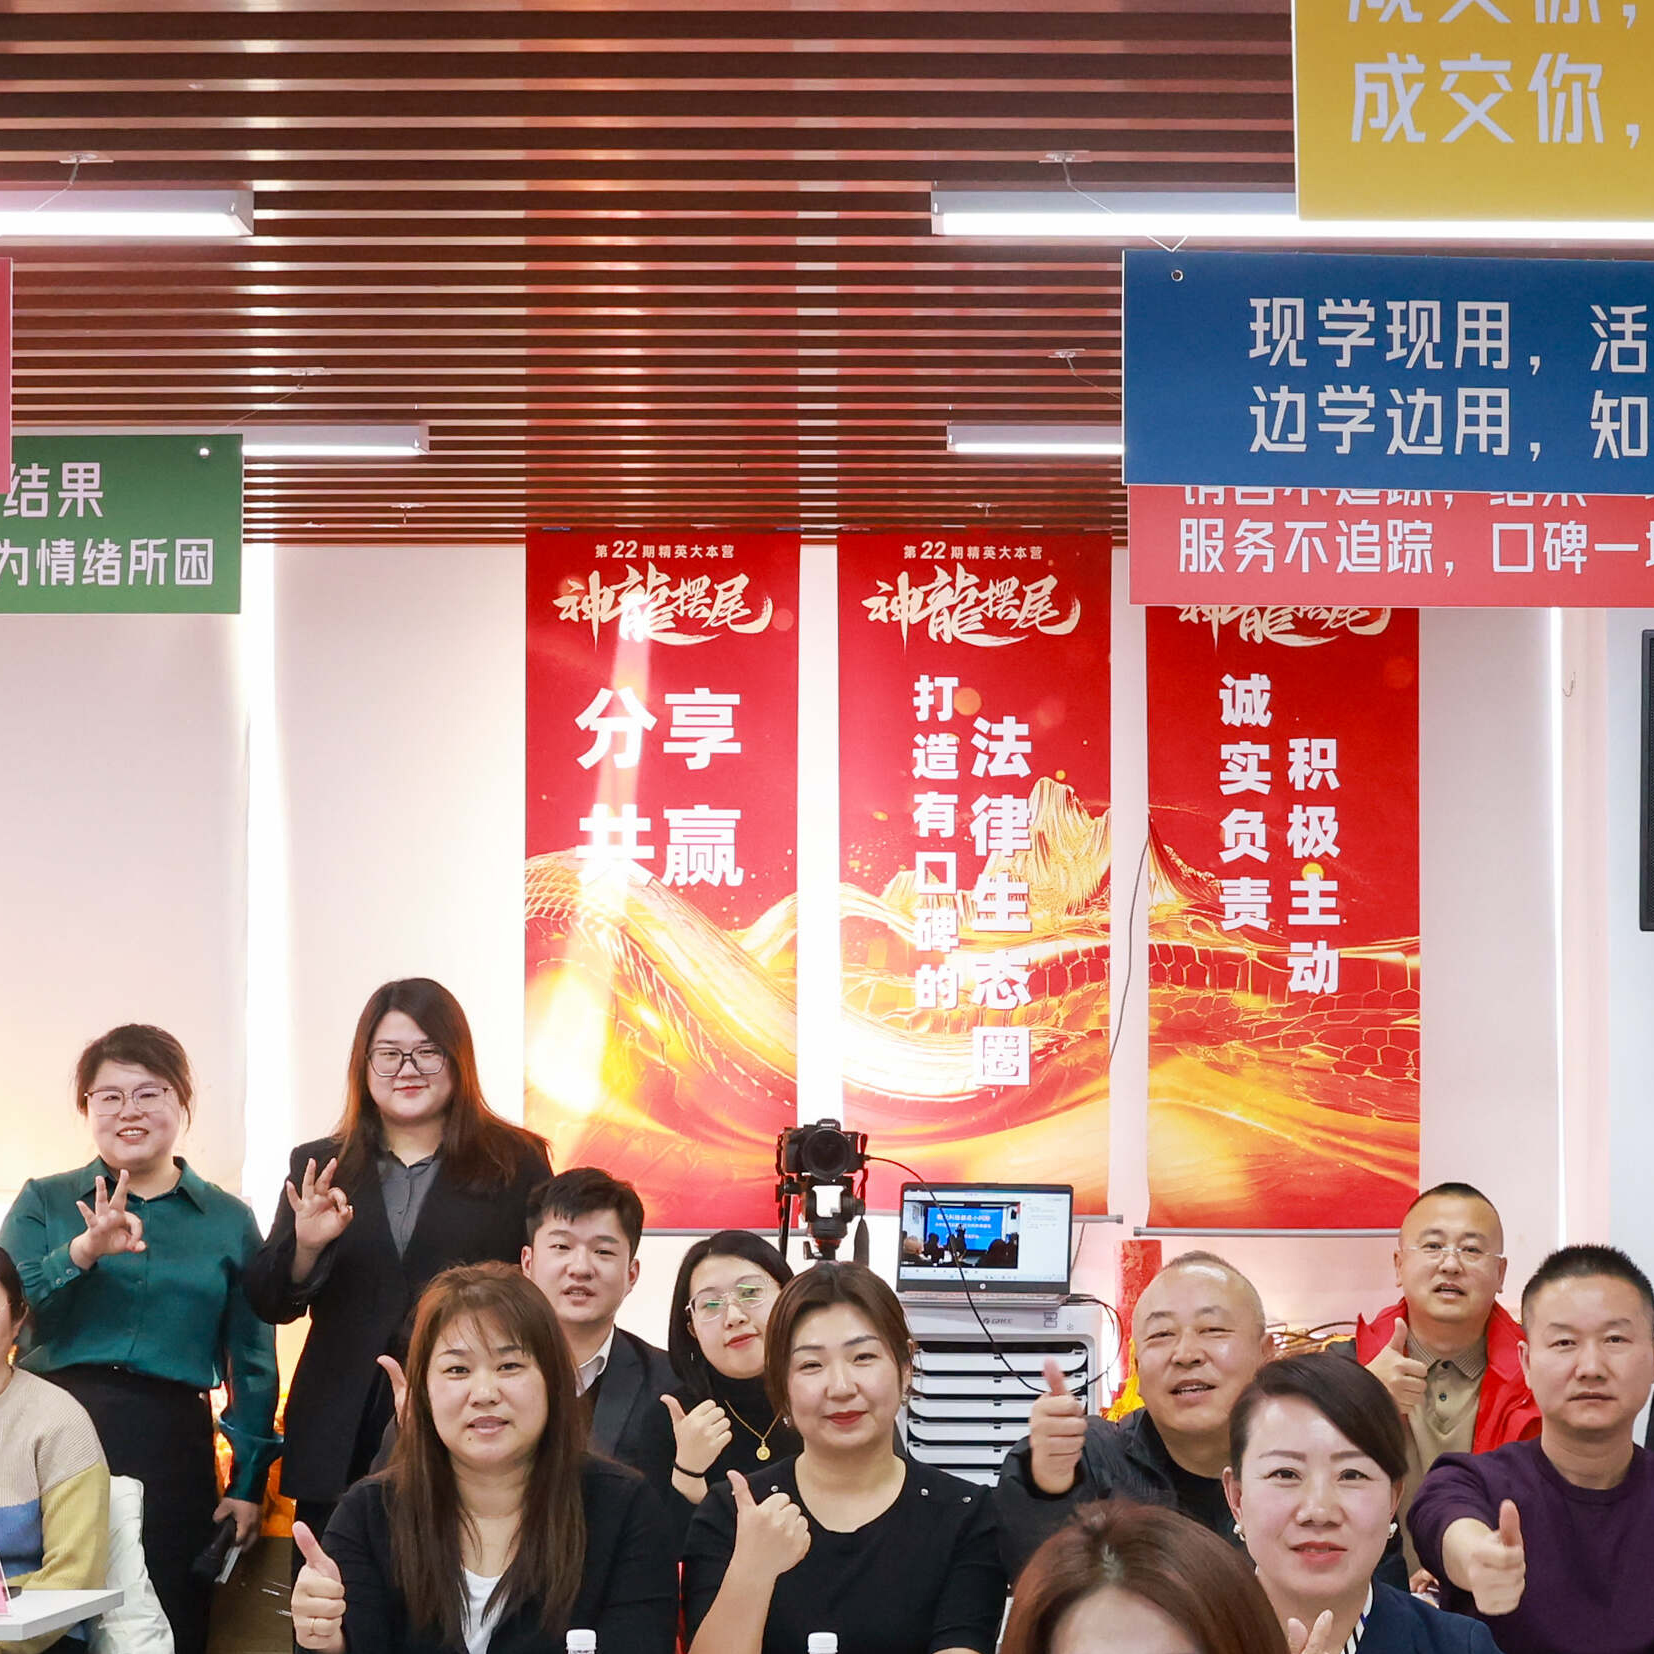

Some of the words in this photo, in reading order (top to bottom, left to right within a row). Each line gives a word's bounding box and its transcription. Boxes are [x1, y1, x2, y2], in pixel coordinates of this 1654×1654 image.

[575, 687, 743, 771] 分享
[576, 804, 745, 888] 共赢
[912, 675, 961, 1011] 打造有口碑的
[1218, 672, 1274, 933] 诚实负责
[971, 716, 1034, 1086] 法律生态圈
[1286, 737, 1341, 995] 积极主动
